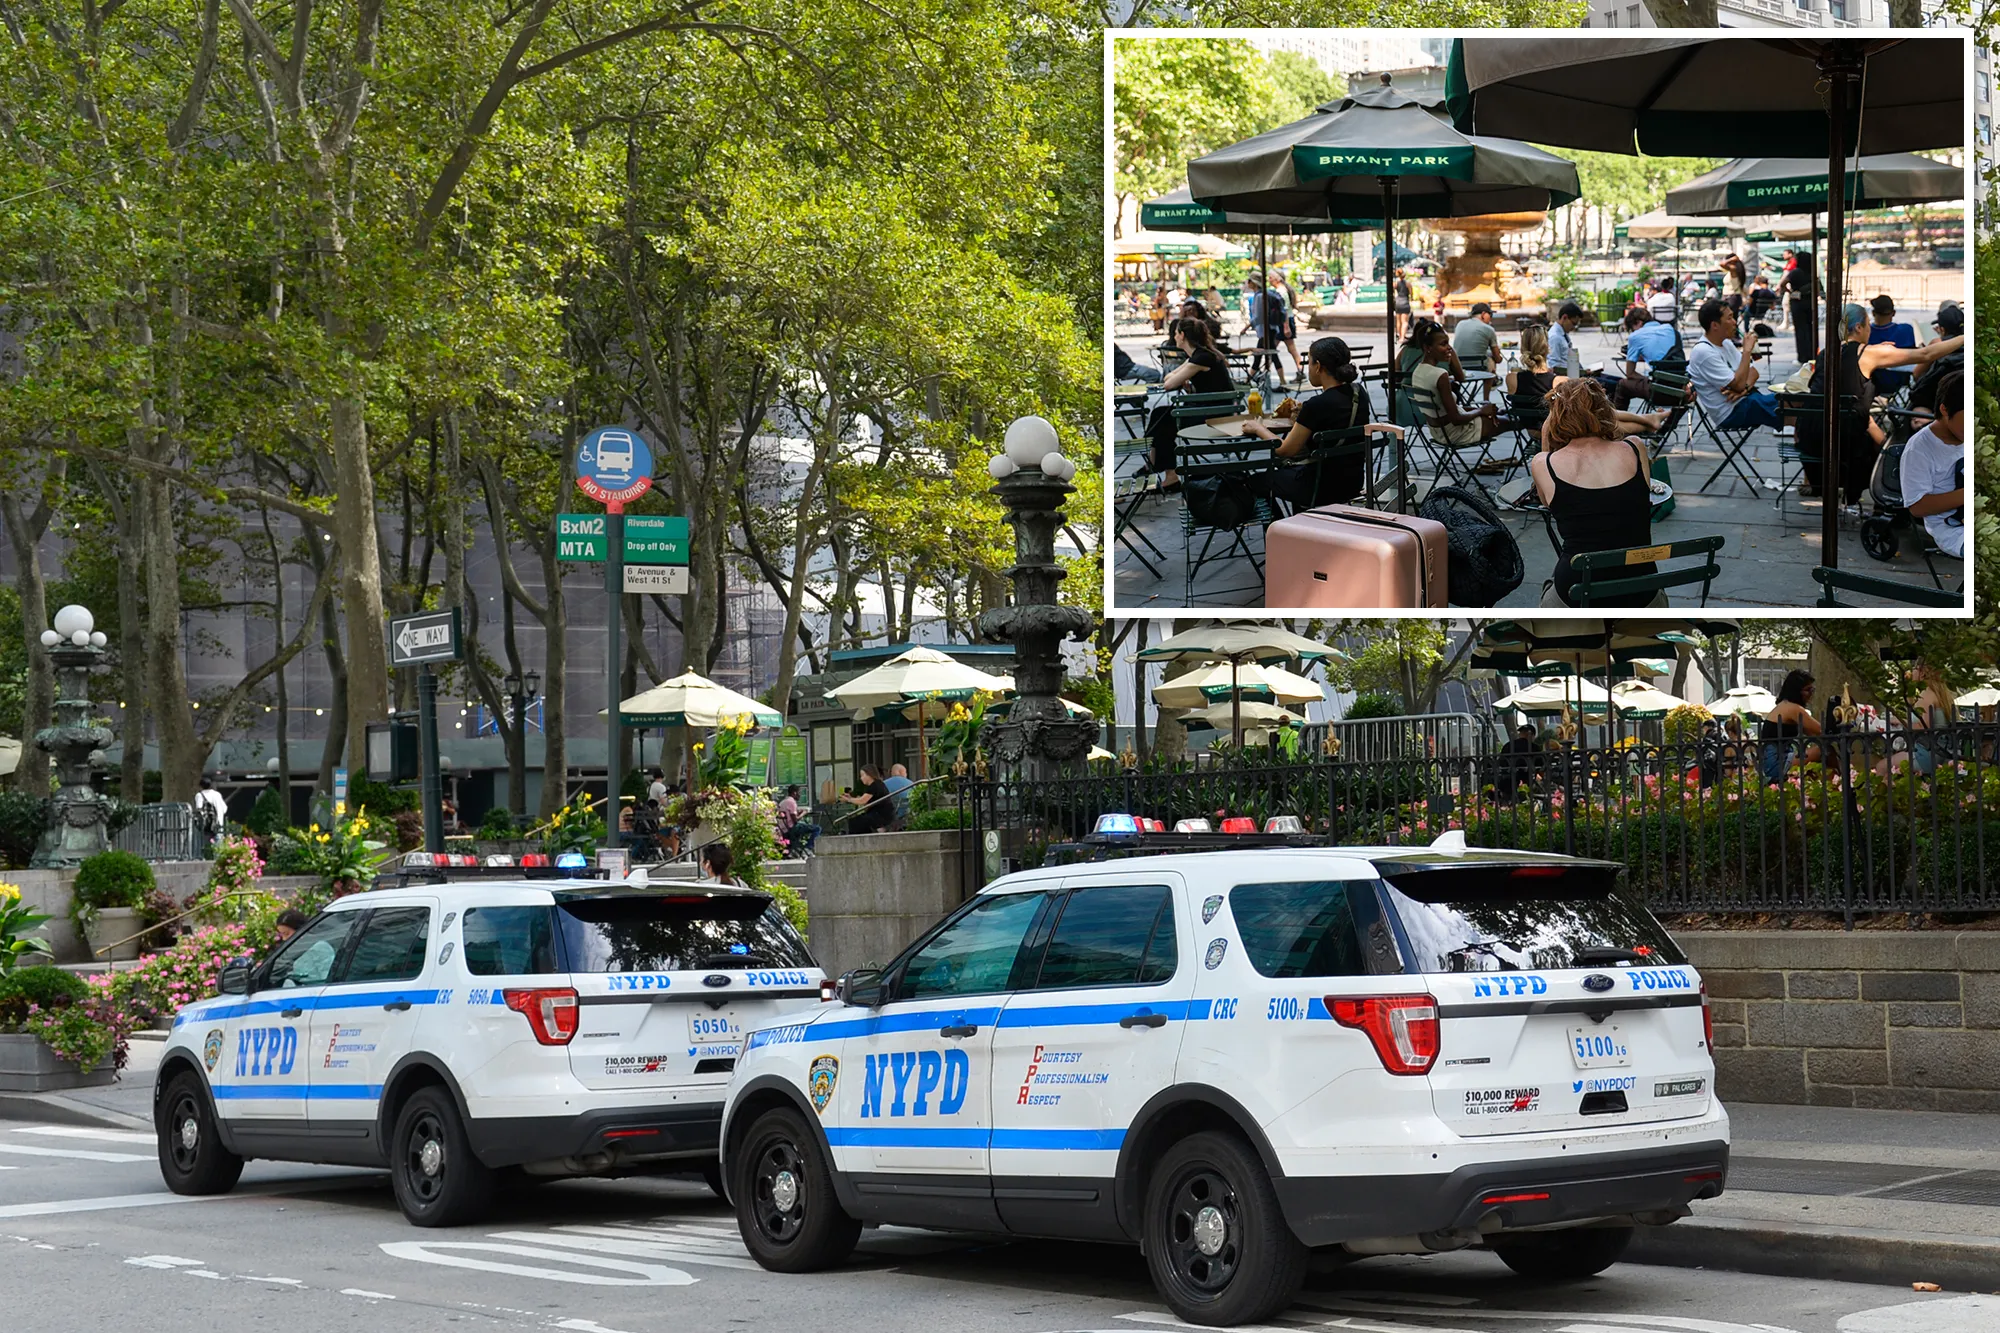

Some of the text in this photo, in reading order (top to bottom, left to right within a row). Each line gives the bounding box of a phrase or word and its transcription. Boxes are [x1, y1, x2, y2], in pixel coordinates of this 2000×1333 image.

[1319, 156, 1449, 166] BRYANT PARK
[1748, 182, 1829, 197] BRYANT PAR
[1154, 209, 1187, 218] BRYANT
[583, 481, 646, 500] NO STANDING
[560, 518, 604, 535] BxM2
[627, 519, 665, 528] Riverdale
[560, 542, 595, 556] MTA
[627, 542, 676, 552] Drop off Only
[627, 567, 676, 576] 6 Avenue &
[627, 576, 671, 584] West 41 St
[402, 627, 445, 647] ONE WAY
[607, 975, 671, 990] NYPD
[745, 971, 809, 986] POLICE
[1625, 969, 1691, 990] POLICE
[1471, 976, 1547, 997] NYPD
[1213, 998, 1238, 1020] CRC
[1267, 997, 1298, 1020] 5100
[693, 1018, 728, 1034] 5050
[765, 1025, 804, 1047] POLICE
[235, 1026, 297, 1077] NYPD
[700, 1045, 740, 1056] @NYPDC
[1575, 1035, 1627, 1058] 5100 16
[605, 1056, 635, 1068] $10,000
[860, 1049, 969, 1118] NYPD
[1585, 1076, 1637, 1092] @NYPDCT
[1465, 1089, 1502, 1103] $10,000
[1504, 1087, 1540, 1100] REWARD
[1465, 1106, 1480, 1115] CALL
[1482, 1105, 1498, 1114] 1-800
